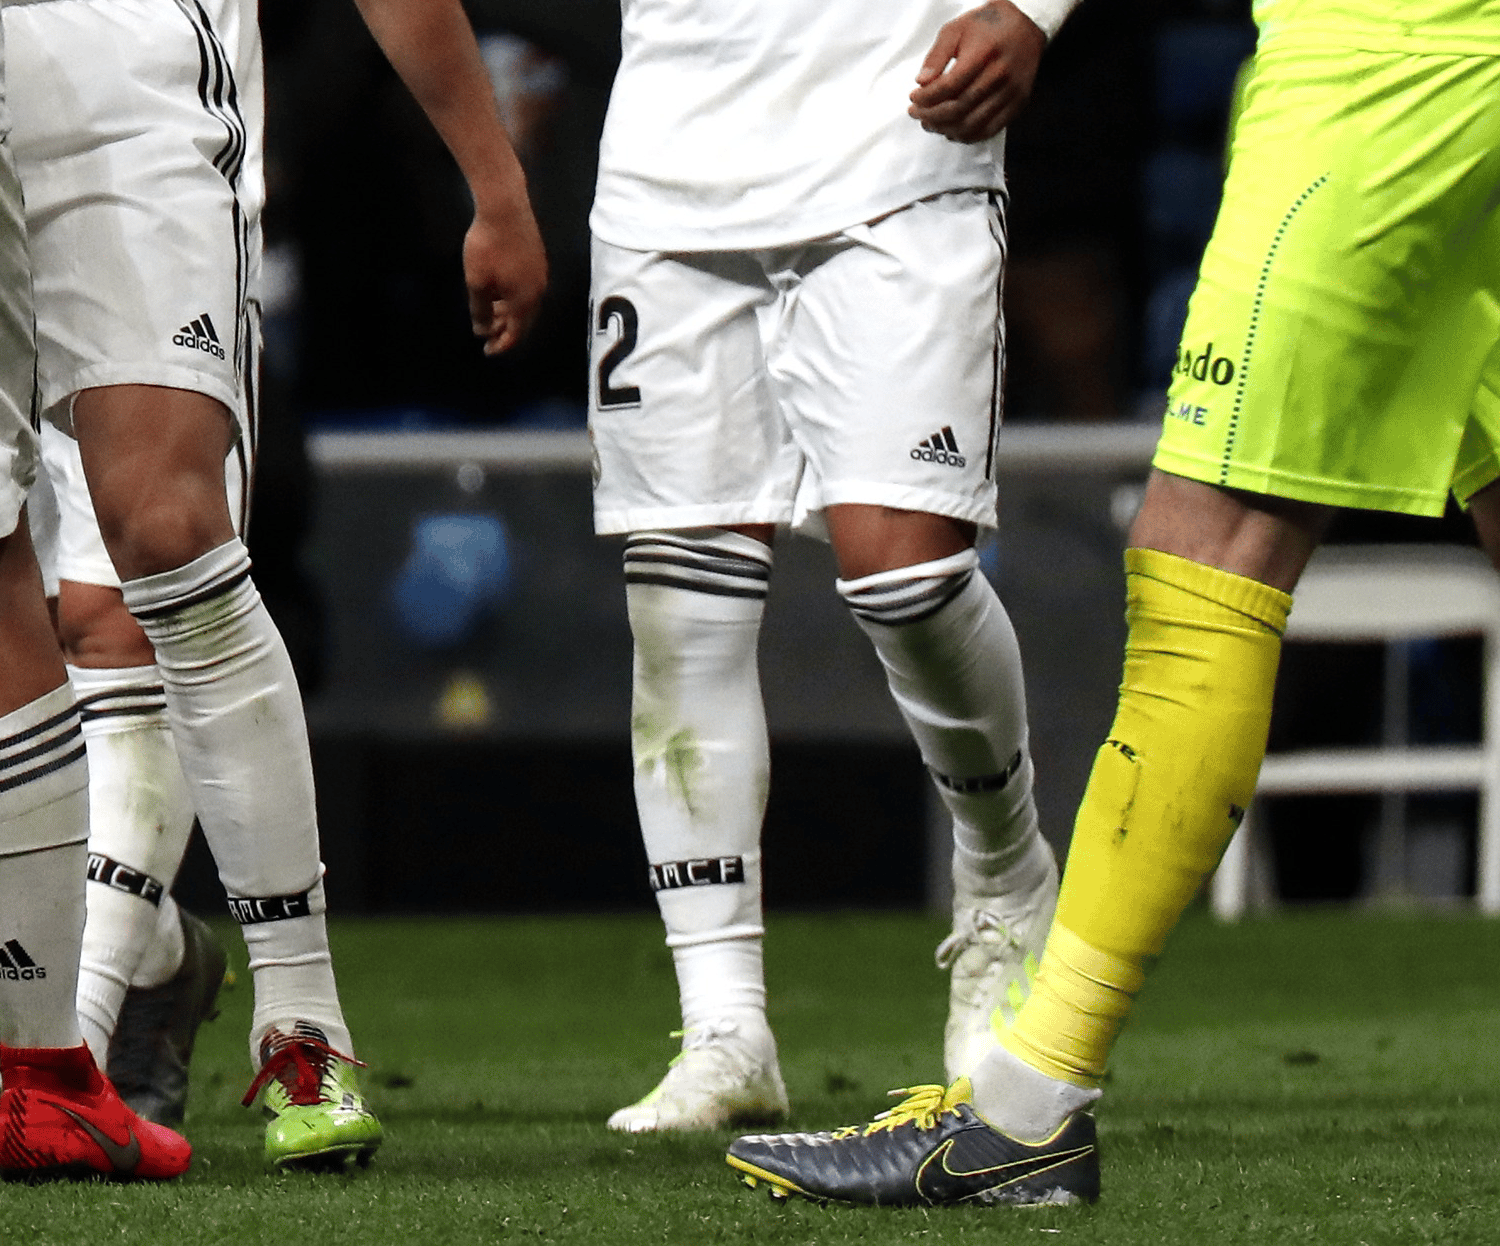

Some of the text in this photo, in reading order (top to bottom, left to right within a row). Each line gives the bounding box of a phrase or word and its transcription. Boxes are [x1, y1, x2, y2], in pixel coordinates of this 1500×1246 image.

[172, 331, 226, 361] adidas
[590, 295, 641, 411] 2
[910, 447, 966, 468] adidas
[87, 854, 161, 897] MCF
